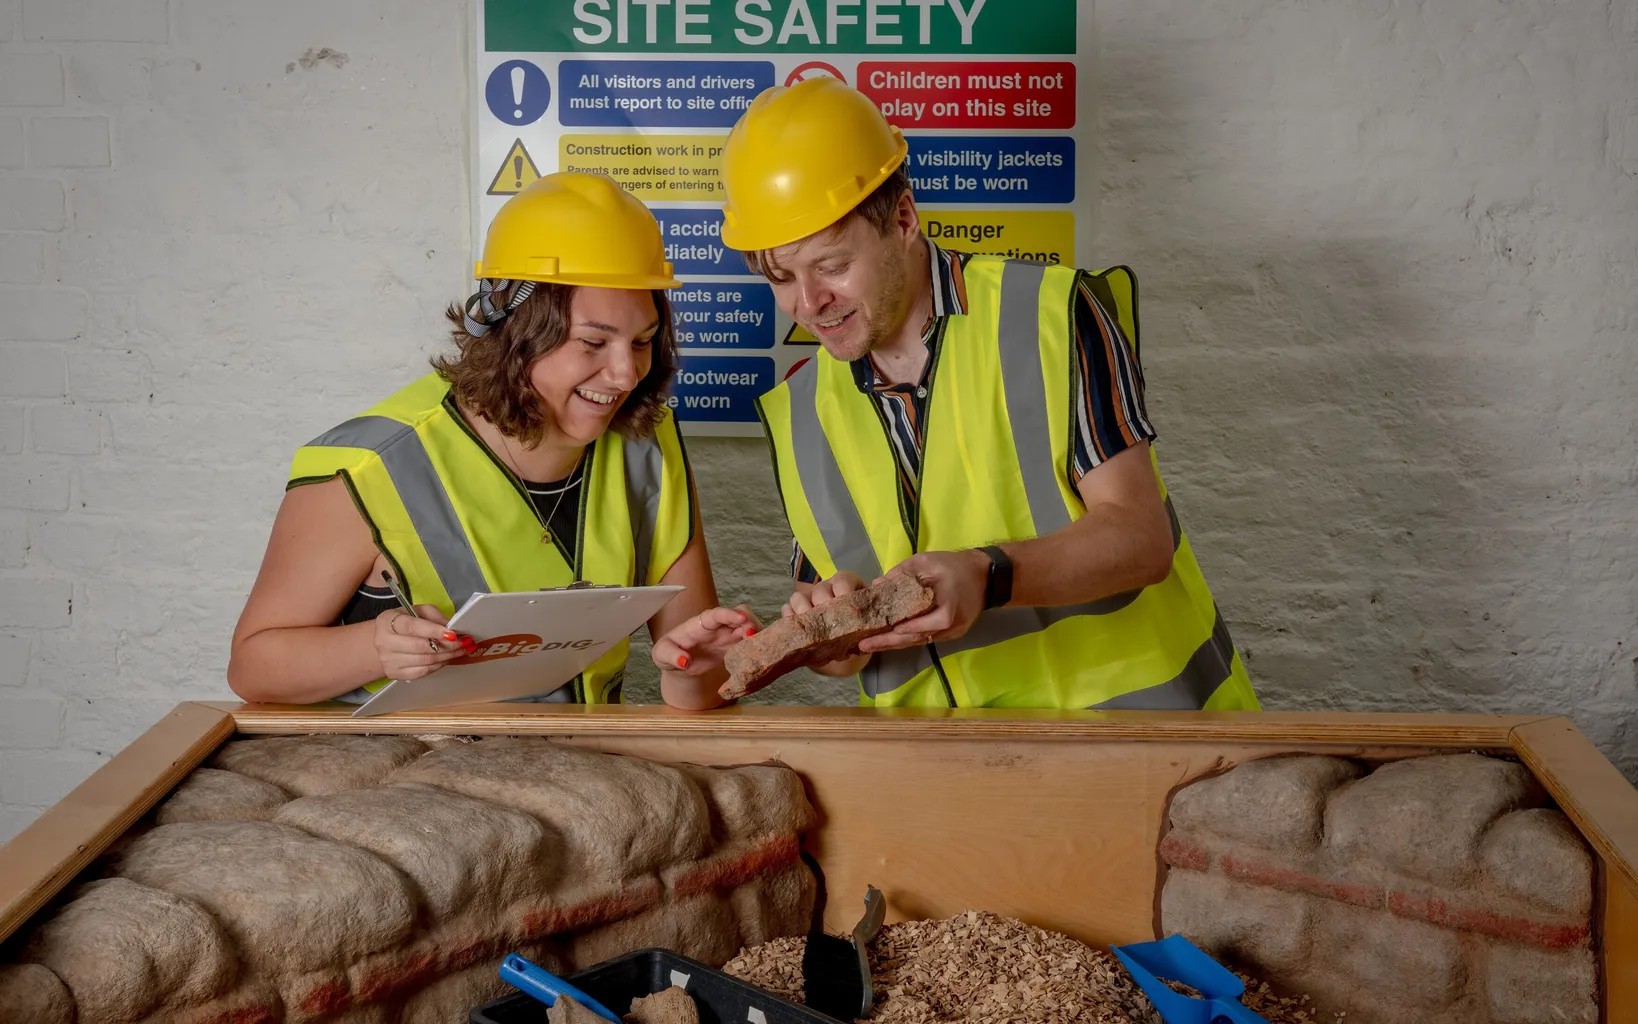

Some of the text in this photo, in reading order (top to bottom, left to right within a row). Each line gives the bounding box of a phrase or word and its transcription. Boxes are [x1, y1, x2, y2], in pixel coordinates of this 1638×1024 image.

[572, 0, 987, 46] SITE SAFETY
[579, 74, 756, 90] All visitors and drivers
[869, 71, 1063, 90] Children must not
[570, 96, 752, 112] must report to site offic
[881, 99, 1052, 121] play on this site
[566, 143, 723, 159] Construction work in pr
[916, 150, 993, 171] visibility
[997, 151, 1063, 171] jackets
[612, 166, 630, 176] are
[632, 166, 675, 176] advised
[678, 166, 690, 176] to
[692, 168, 719, 176] warn
[616, 181, 652, 192] ngers
[655, 180, 667, 190] of
[669, 180, 715, 192] entering
[908, 174, 1028, 190] must be worn
[670, 220, 721, 237] accid
[927, 220, 1005, 243] Danger
[664, 244, 724, 264] diately
[665, 289, 742, 303] lmets are
[674, 309, 764, 326] your safety
[675, 329, 739, 343] be worn
[676, 368, 759, 386] footwear
[684, 396, 731, 408] worn
